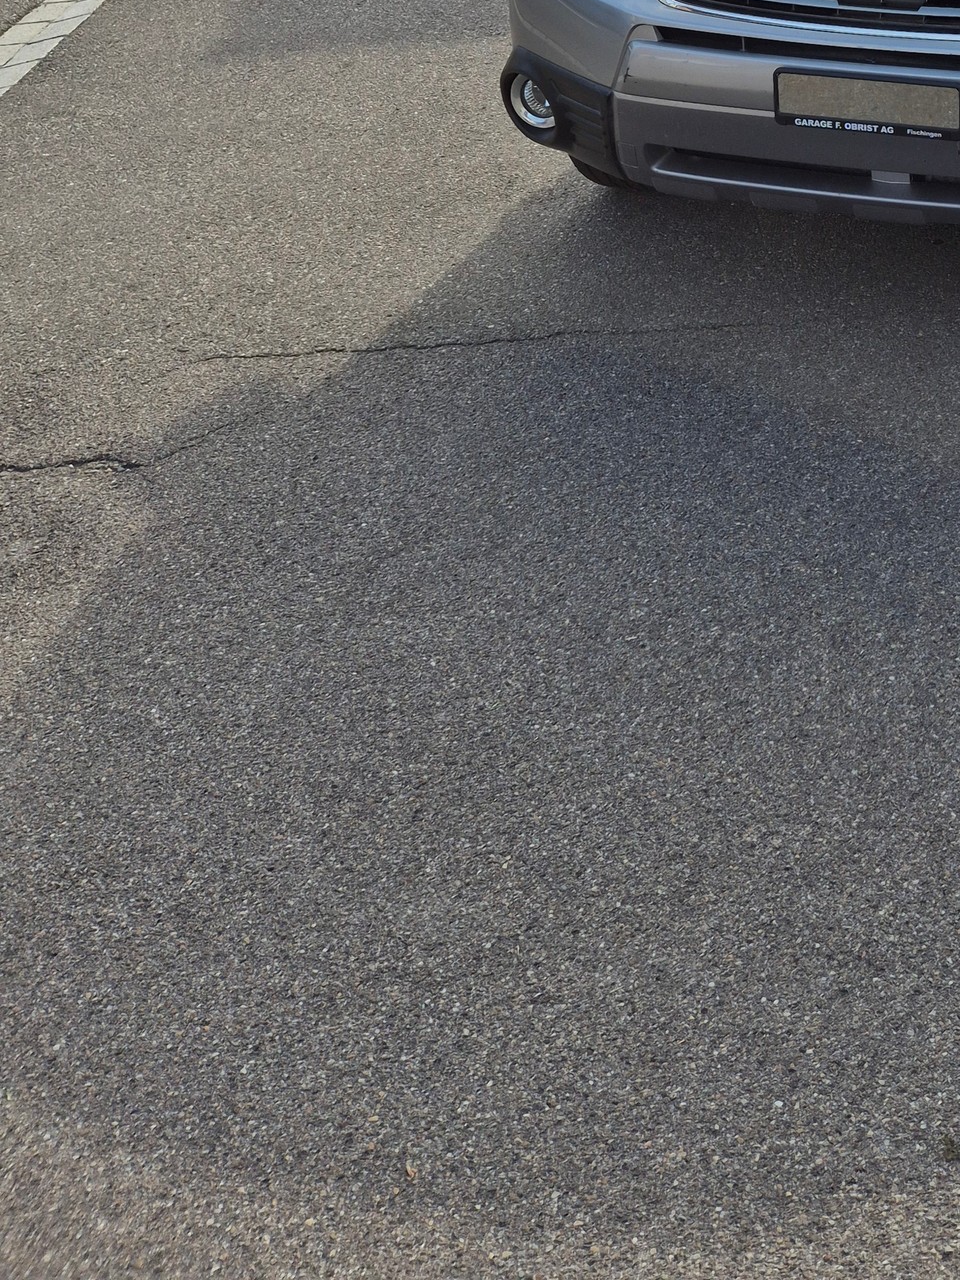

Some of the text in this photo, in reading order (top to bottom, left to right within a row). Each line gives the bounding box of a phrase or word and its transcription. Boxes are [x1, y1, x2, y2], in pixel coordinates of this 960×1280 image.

[794, 118, 894, 134] GARAGE F. OBRIST AG
[906, 128, 943, 139] Fischingen
